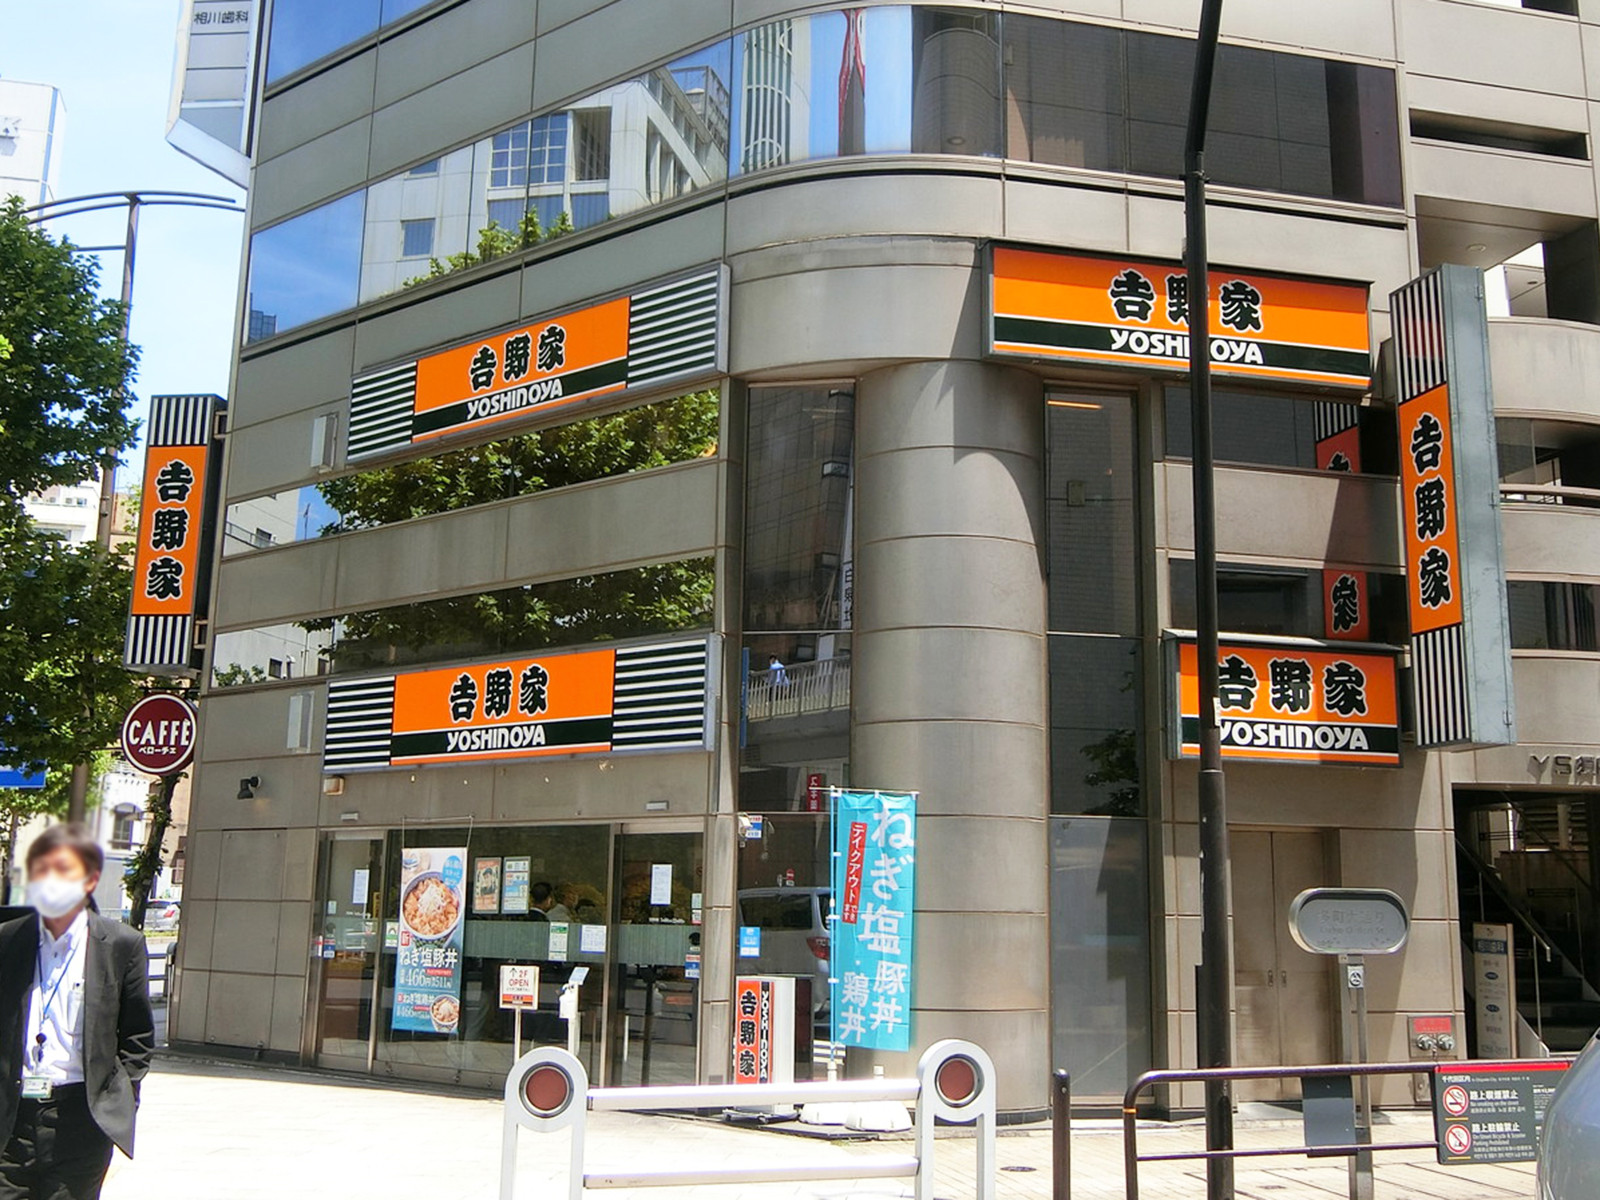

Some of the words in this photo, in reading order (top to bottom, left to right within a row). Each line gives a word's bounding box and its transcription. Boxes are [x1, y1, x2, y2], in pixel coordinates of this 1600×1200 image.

[193, 10, 249, 24] 相川歯科
[469, 324, 566, 392] 吉野家
[1110, 329, 1264, 364] YOSHIOYA
[467, 379, 563, 420] YOSHINOYA
[145, 459, 195, 601] 吉野家
[1410, 412, 1452, 610] 吉野家
[449, 663, 549, 723] 吉野家
[1219, 653, 1369, 718] 吉野家
[447, 725, 546, 752] YOSHINOYA
[1529, 753, 1600, 776] YS須
[857, 799, 914, 1034] ねぎ塩豚丼
[508, 979, 529, 987] OPEN
[739, 990, 758, 1077] 吉野家
[760, 991, 769, 1078] YOSHINOYA
